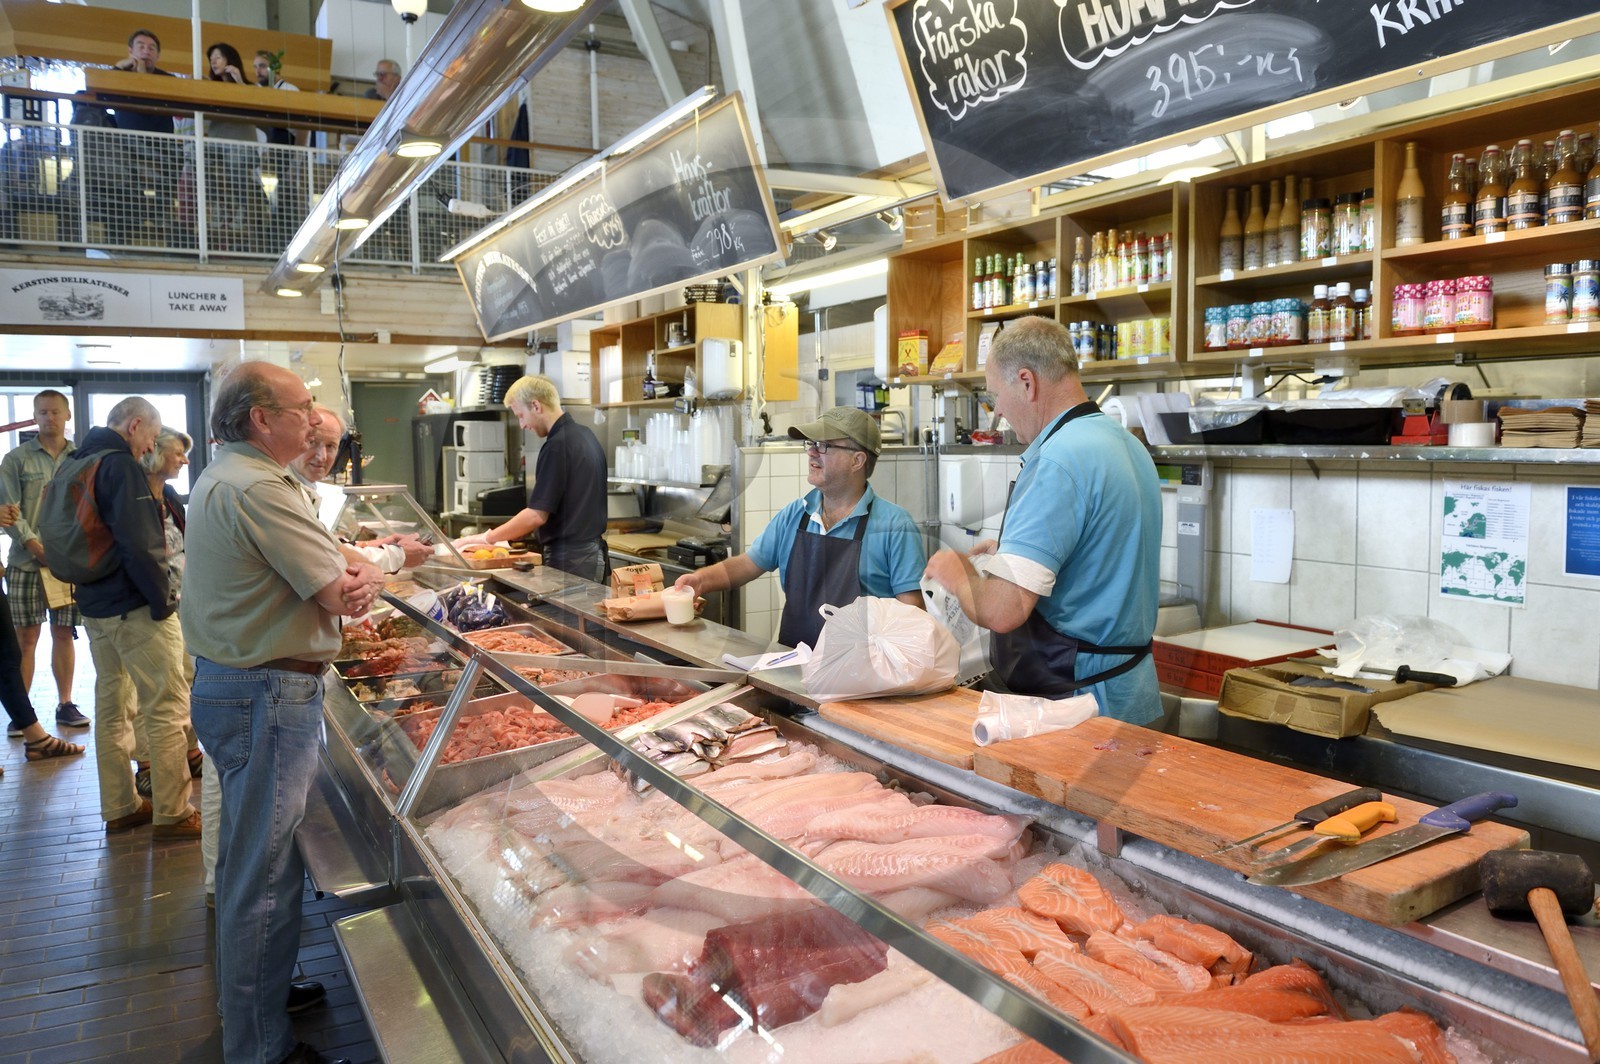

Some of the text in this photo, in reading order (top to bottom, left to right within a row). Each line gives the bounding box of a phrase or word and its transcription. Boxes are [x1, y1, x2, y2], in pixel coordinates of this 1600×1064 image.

[948, 50, 1010, 103] räkor
[11, 276, 130, 297] KERSTINS DELIKATESSER
[168, 291, 227, 301] LUNCHER &
[169, 303, 227, 312] TAKE AWAY
